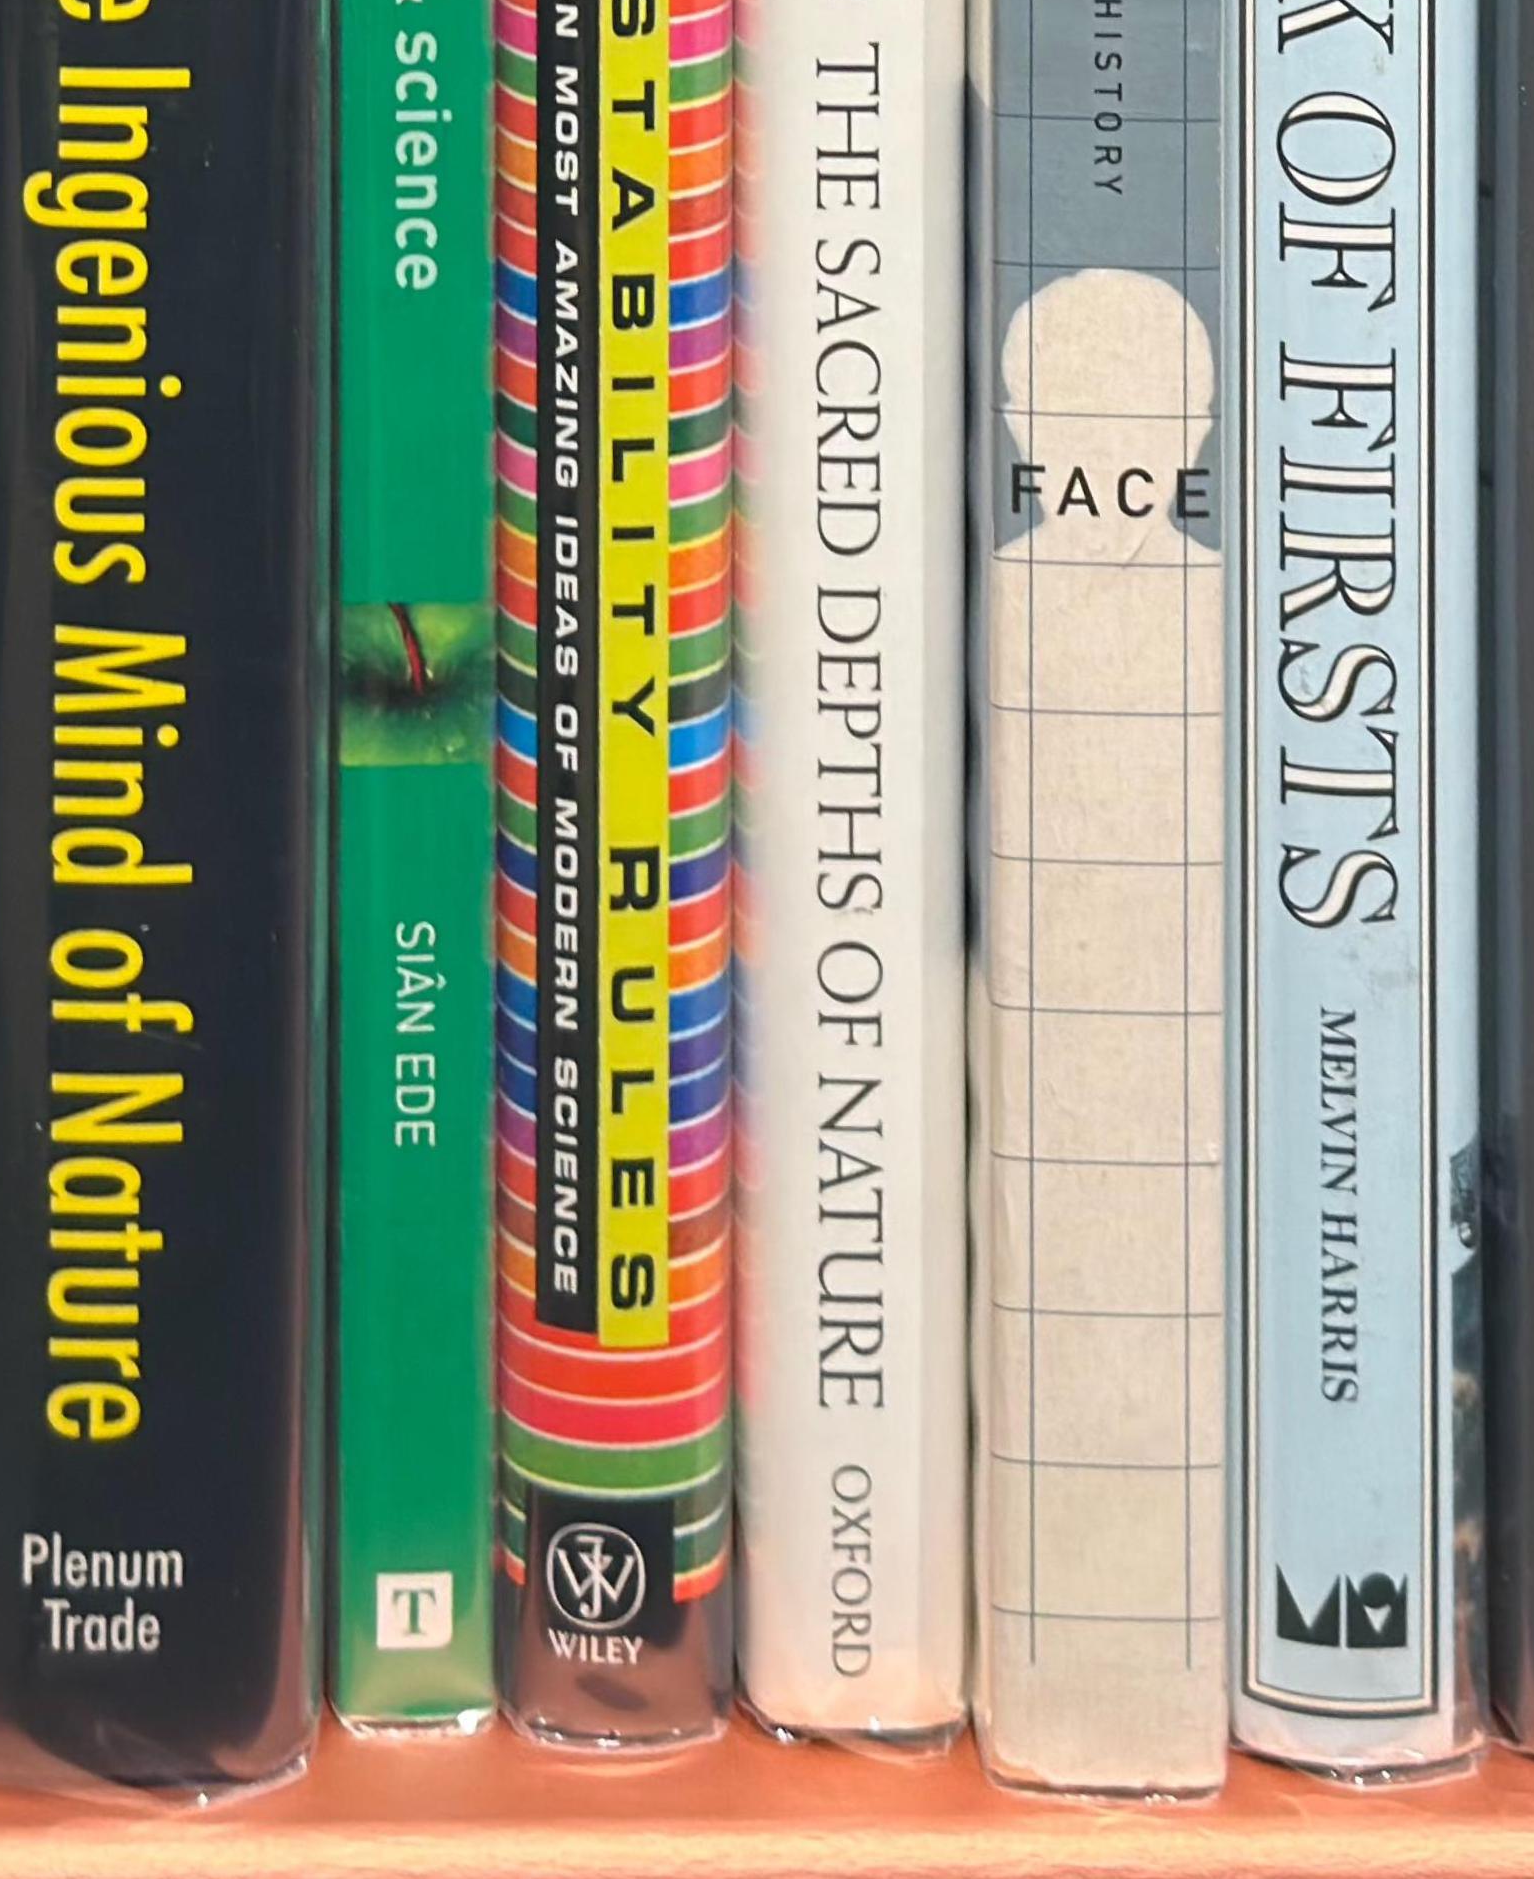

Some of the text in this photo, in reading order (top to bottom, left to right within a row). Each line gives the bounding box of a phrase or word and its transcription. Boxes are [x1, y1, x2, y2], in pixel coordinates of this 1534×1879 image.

[395, 27, 451, 290] science
[554, 66, 579, 215] MOST
[814, 44, 882, 211] THE
[1277, 91, 1397, 312] OF
[23, 67, 192, 586] Ingenious
[552, 243, 579, 492] AMAZING
[816, 235, 883, 558] SACRED
[552, 514, 578, 678] IDEAS
[1009, 462, 1212, 521] FACE
[818, 585, 884, 916] DEPTHS
[1277, 339, 1400, 927] FIRSTS
[53, 626, 194, 883] Mind
[50, 930, 192, 1034] of
[552, 787, 578, 1031] MODERN
[394, 922, 435, 1148] SIÂN EDE
[608, 843, 660, 1314] RULES
[45, 1071, 183, 1442] Nature
[552, 1056, 578, 1297] SCIENCE
[818, 1074, 884, 1410] NATURE
[1319, 1004, 1360, 1405] MELVIN HARRIS
[22, 1534, 183, 1592] Plenum
[45, 1598, 160, 1653] Trade
[549, 1631, 642, 1666] WILEY
[830, 1464, 874, 1680] OXFORD
